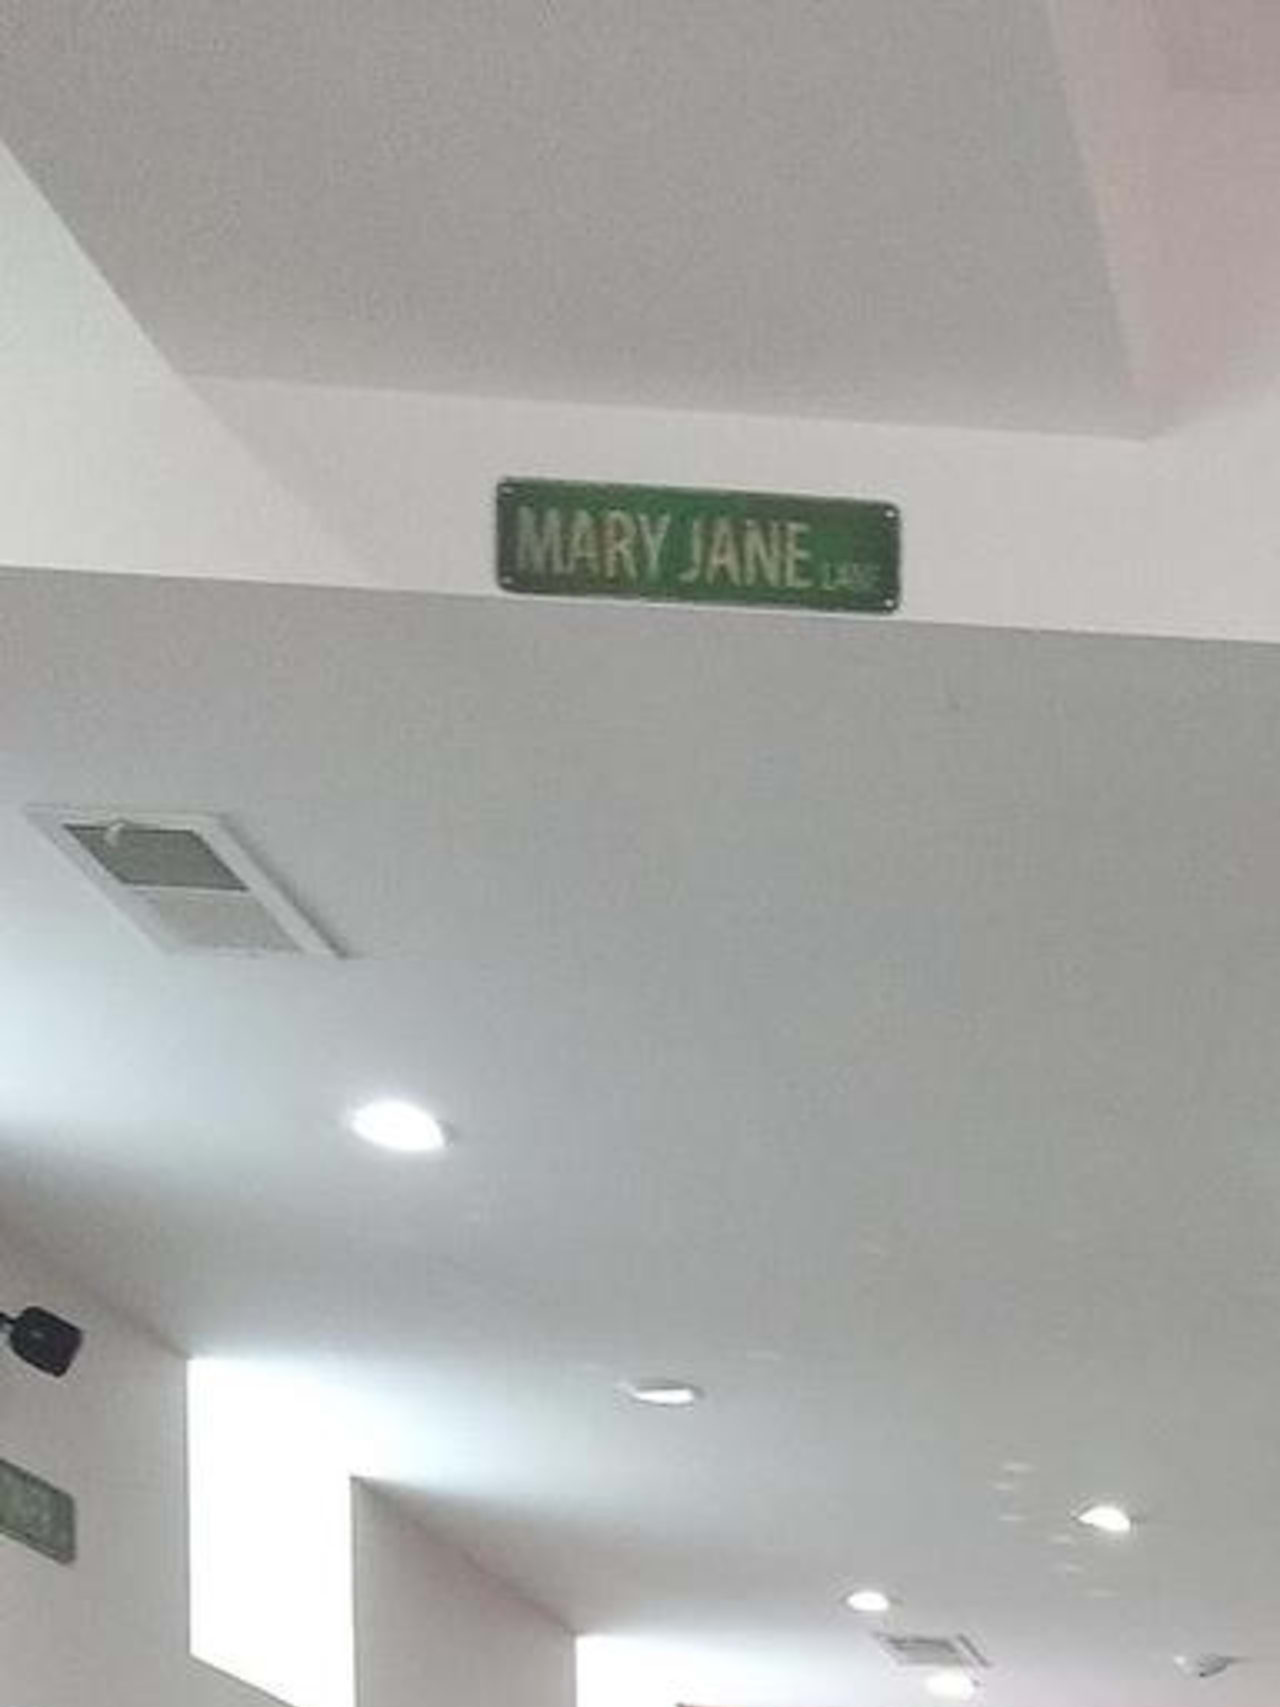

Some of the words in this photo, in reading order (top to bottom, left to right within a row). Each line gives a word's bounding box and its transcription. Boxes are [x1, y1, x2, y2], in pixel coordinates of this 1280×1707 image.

[515, 506, 671, 580] MARY
[678, 519, 815, 588] JANE
[824, 561, 881, 591] LANE
